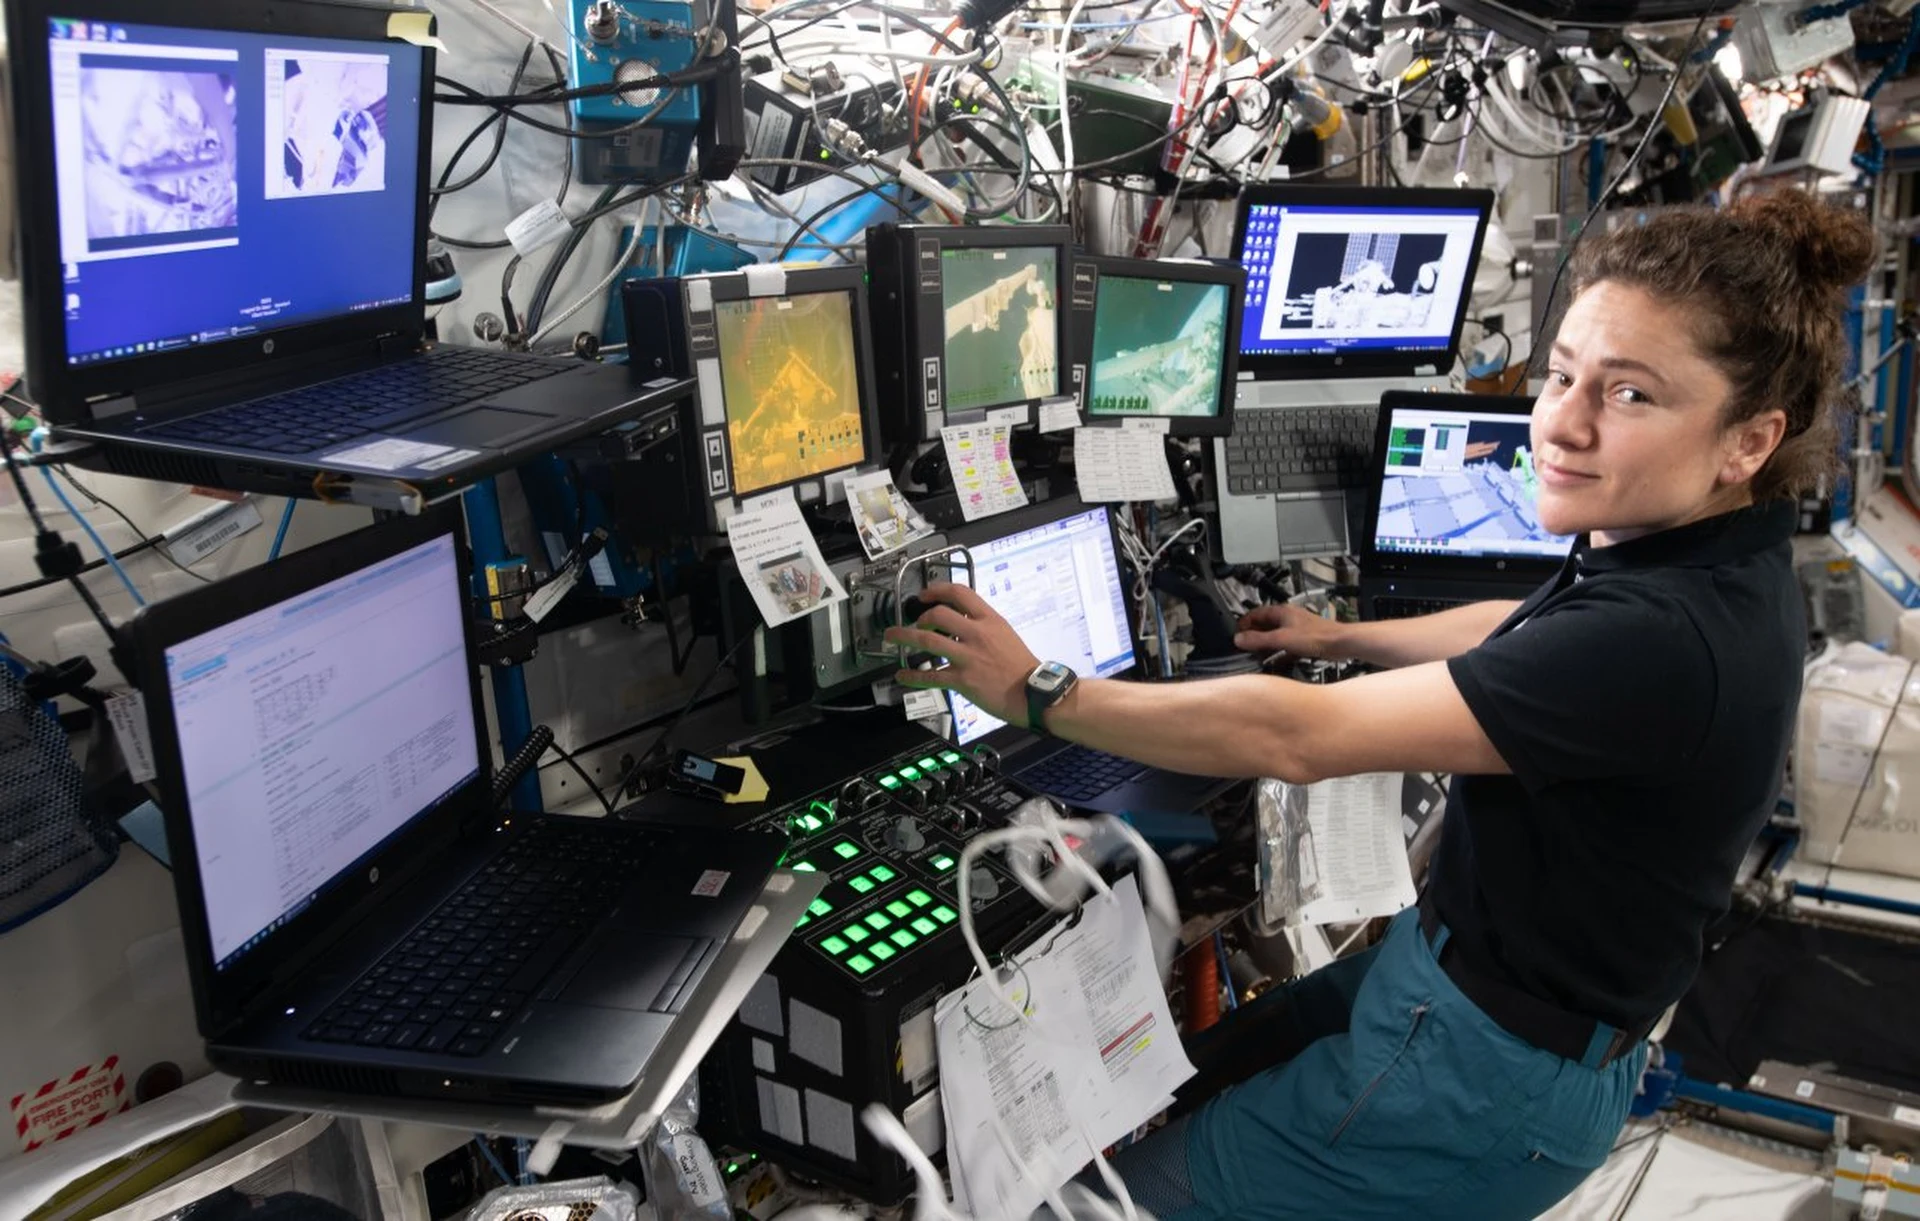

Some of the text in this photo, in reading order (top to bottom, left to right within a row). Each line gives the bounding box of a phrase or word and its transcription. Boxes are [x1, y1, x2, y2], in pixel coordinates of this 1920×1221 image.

[29, 1084, 89, 1115] EMERGENCY
[32, 1083, 111, 1128] FIRE PORT
